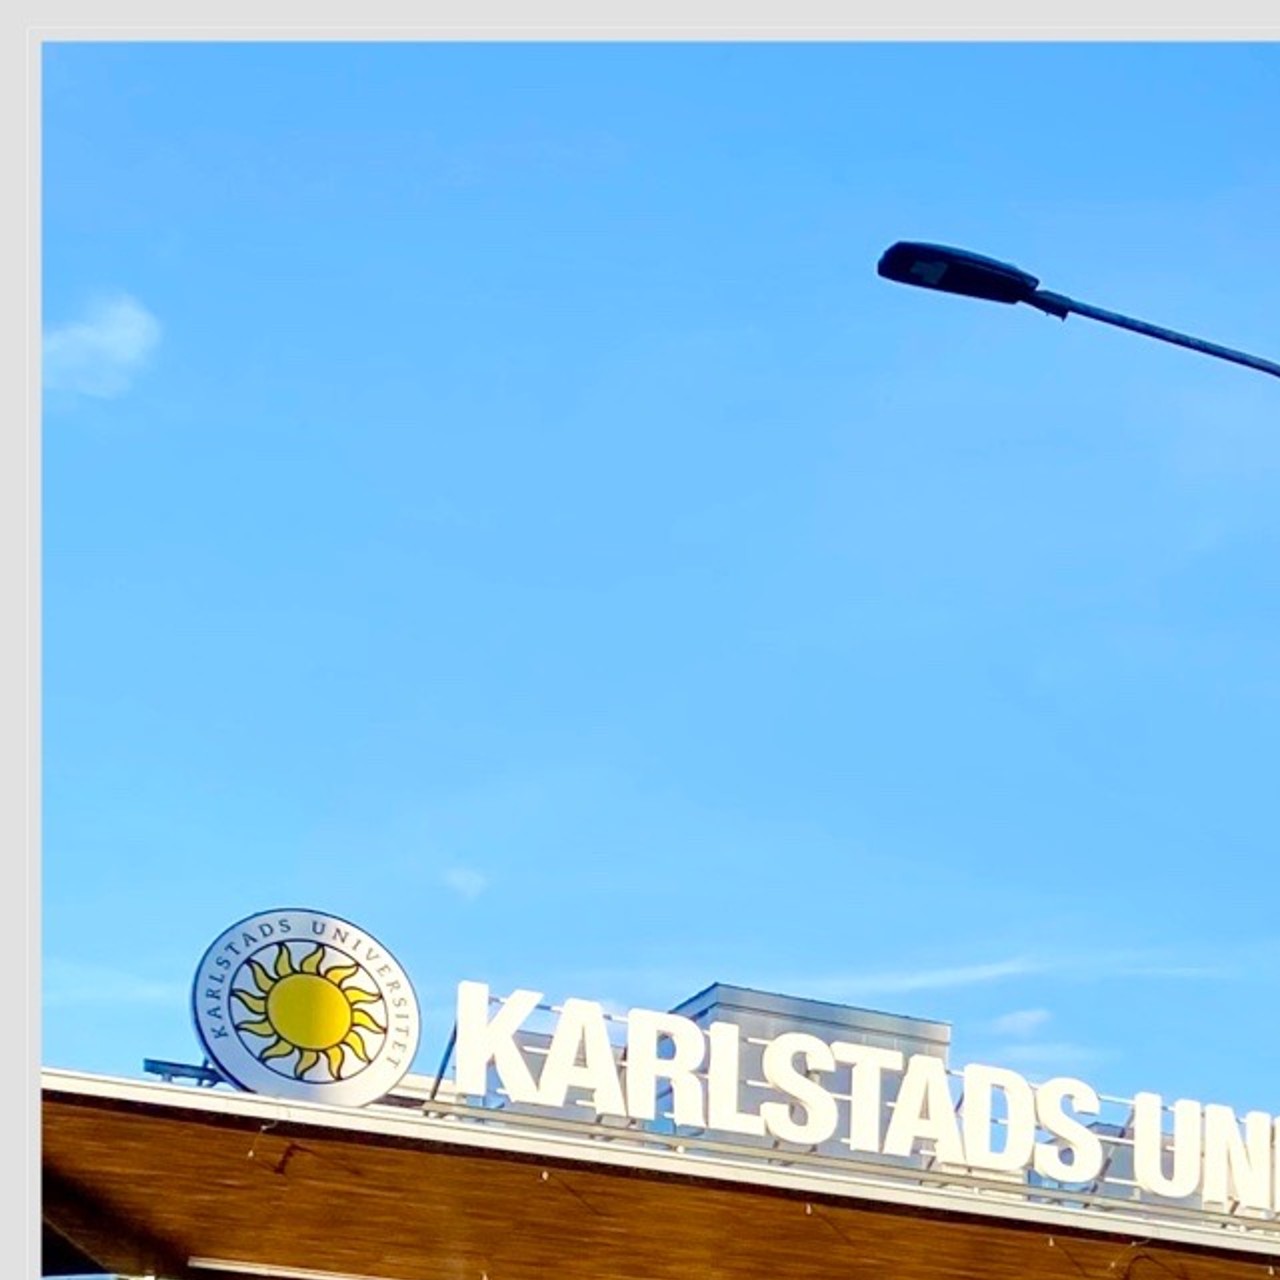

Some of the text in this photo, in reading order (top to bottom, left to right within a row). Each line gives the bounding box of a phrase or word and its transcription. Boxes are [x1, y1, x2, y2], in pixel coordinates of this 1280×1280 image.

[206, 918, 410, 1070] KARLSTADS UNIVERSITET
[455, 980, 1104, 1184] KARLSTADS
